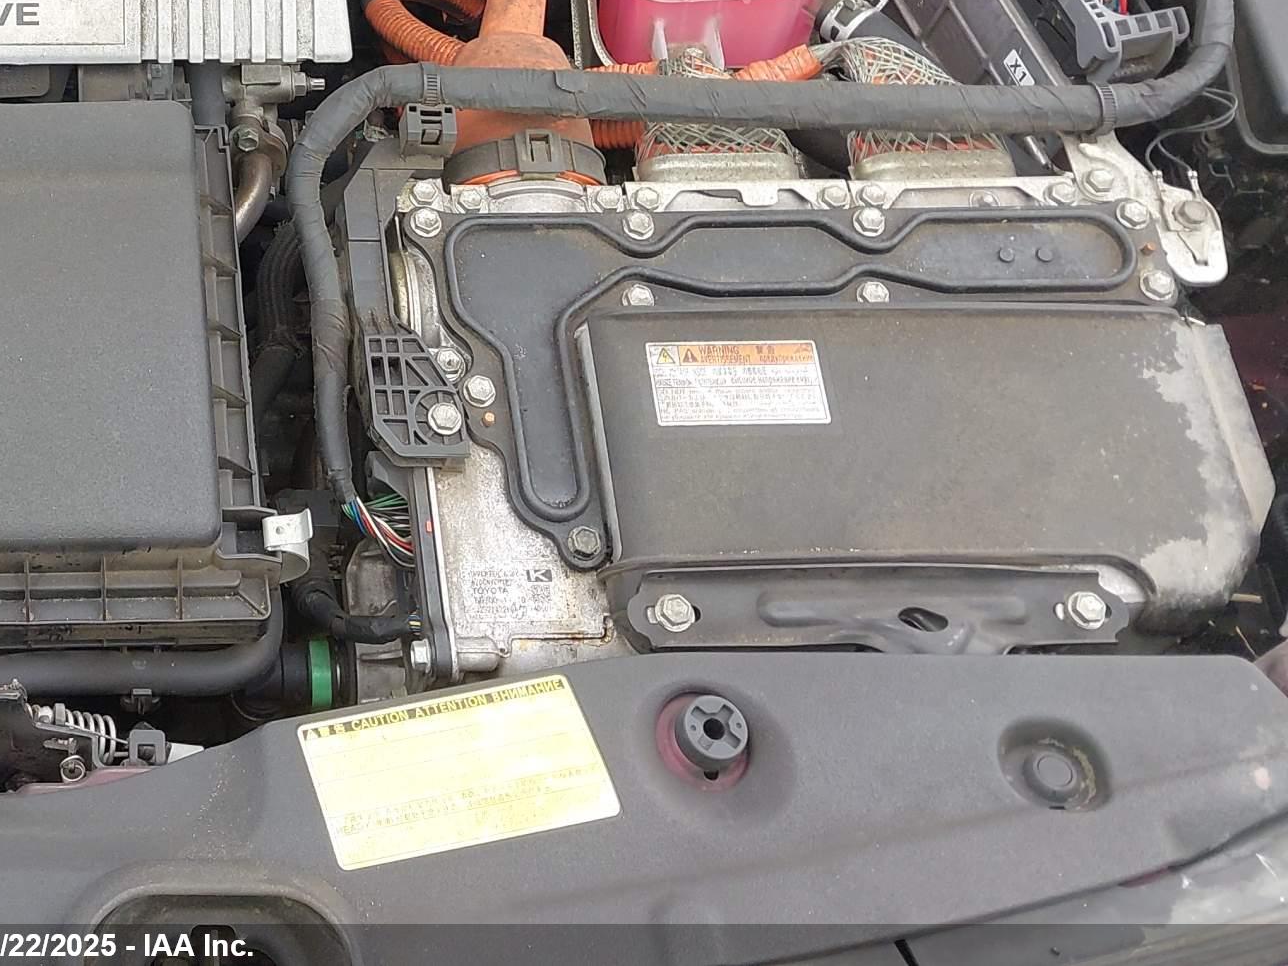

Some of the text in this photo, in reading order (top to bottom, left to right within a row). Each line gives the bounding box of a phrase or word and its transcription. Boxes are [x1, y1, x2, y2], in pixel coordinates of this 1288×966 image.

[698, 345, 740, 355] WARNING
[472, 587, 509, 595] TOYOTA
[352, 710, 408, 731] CAUTION
[415, 694, 488, 718] ATTENTION
